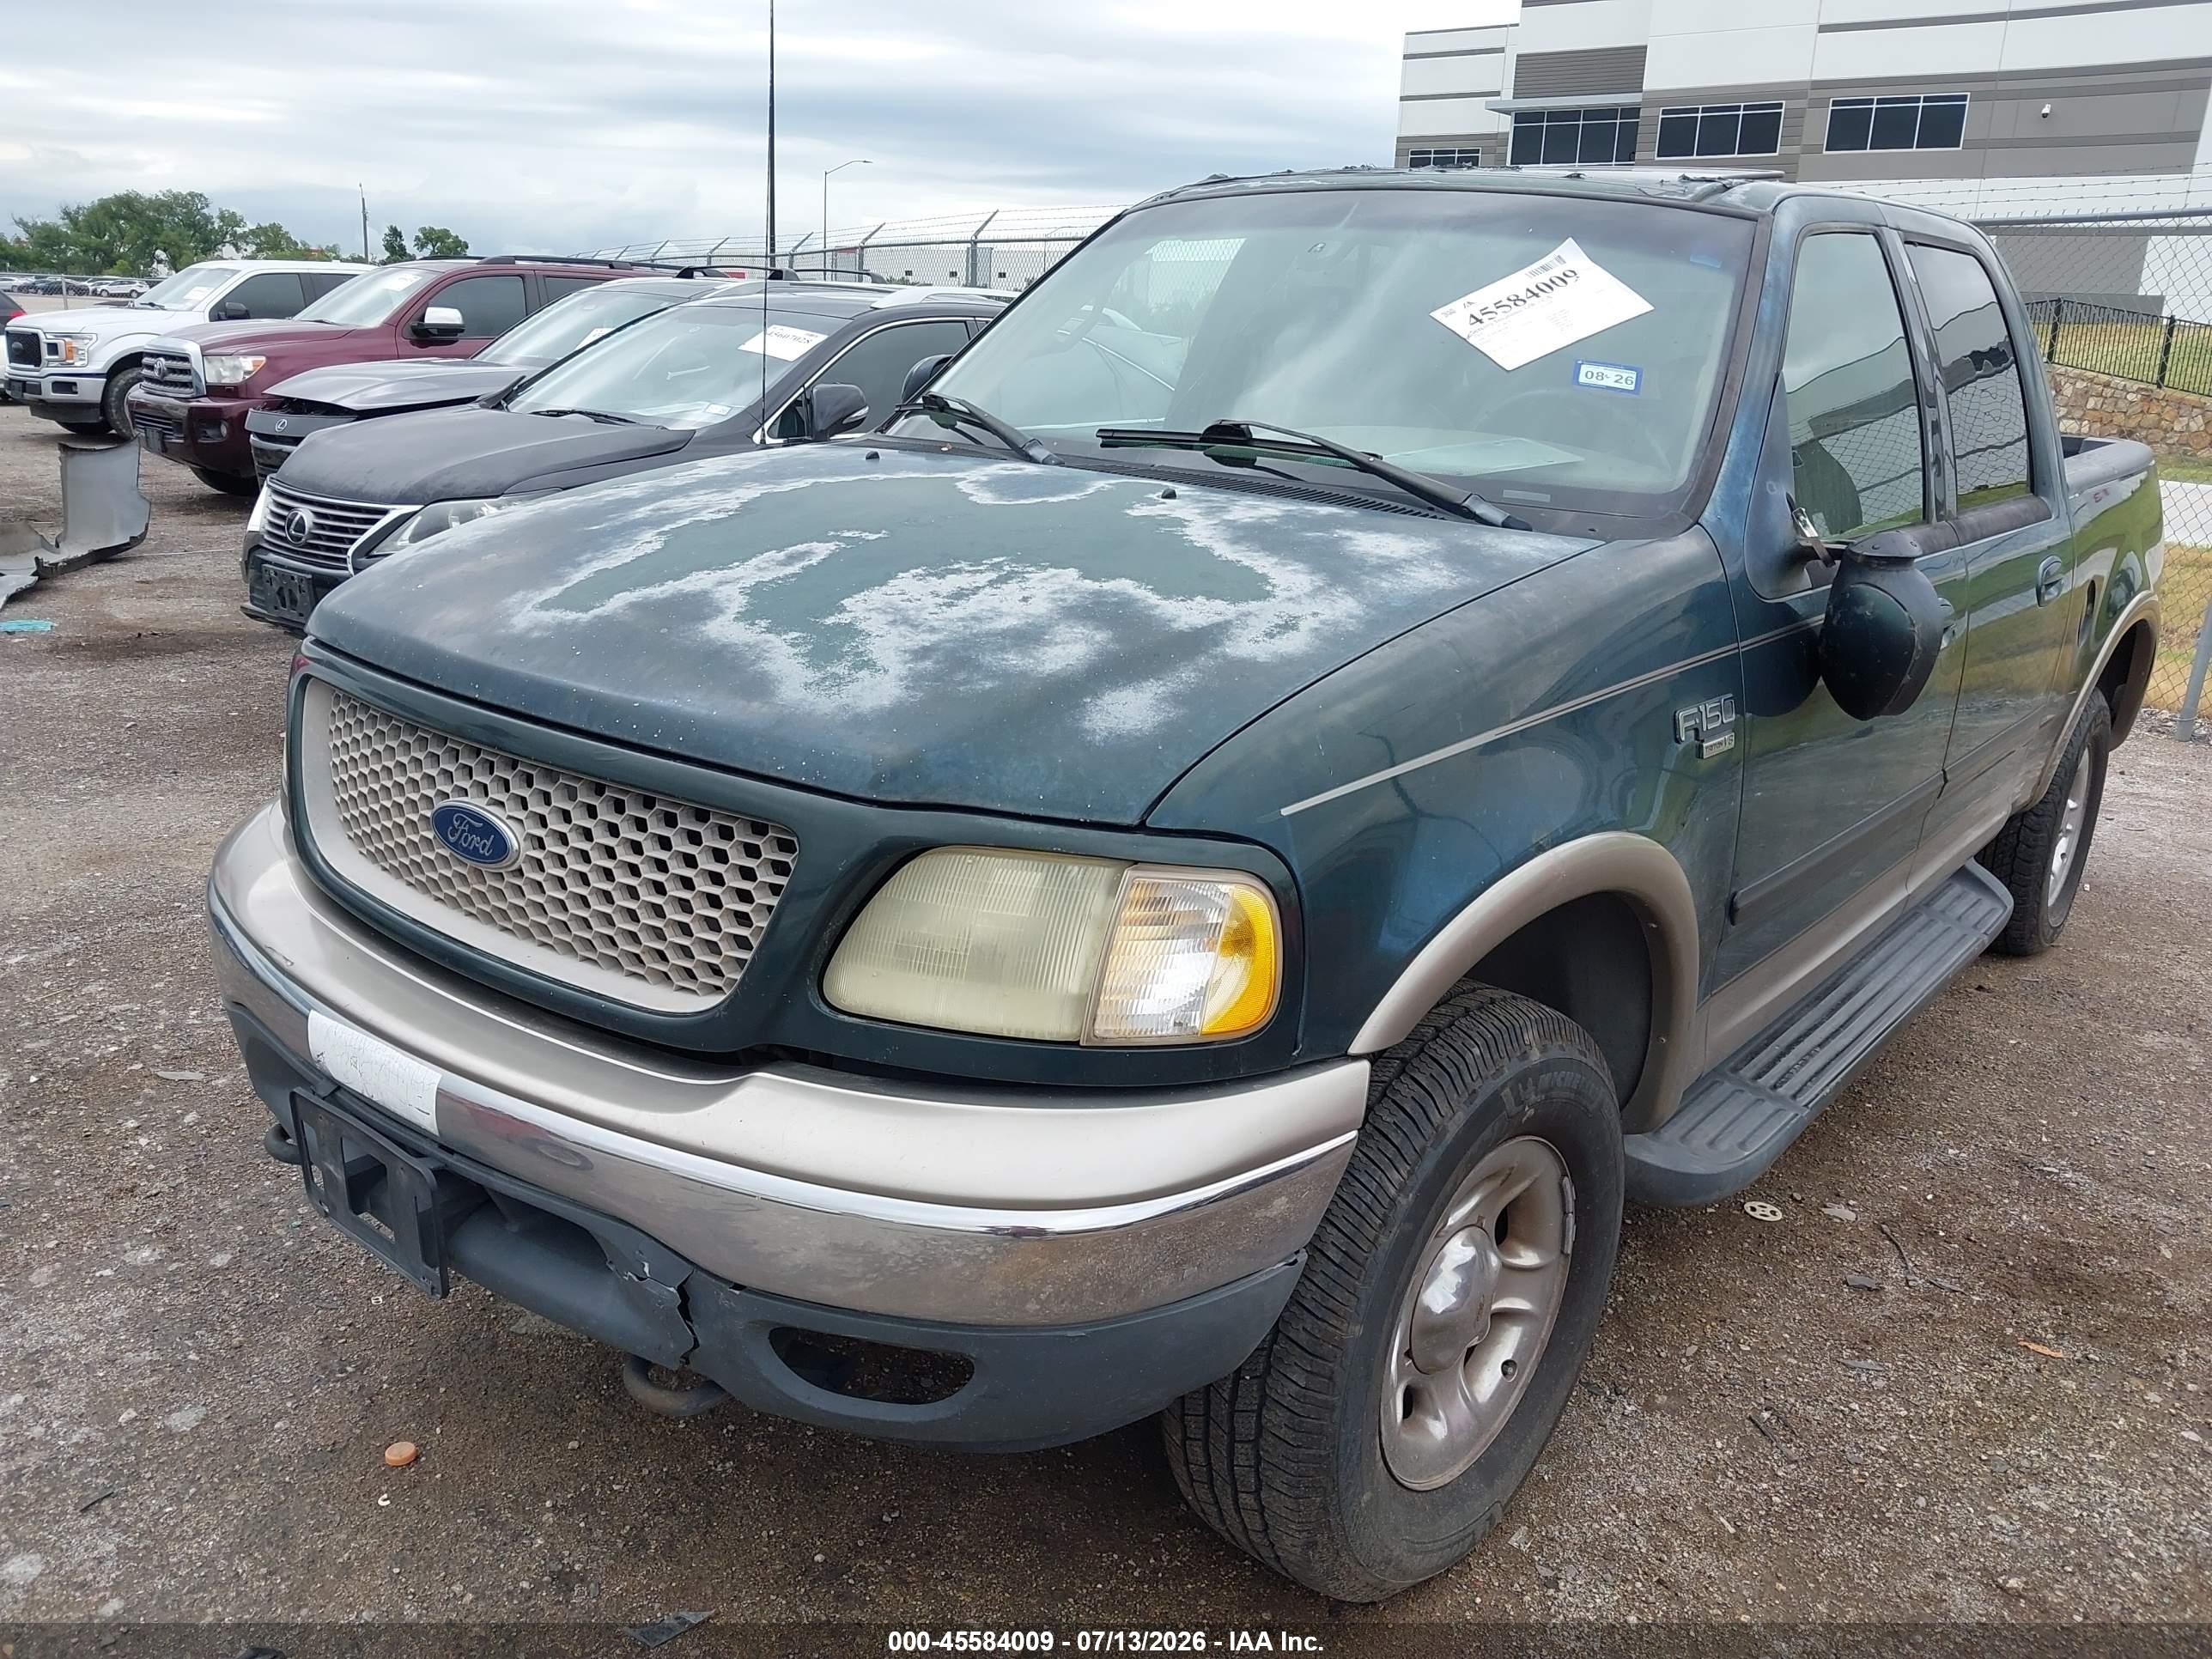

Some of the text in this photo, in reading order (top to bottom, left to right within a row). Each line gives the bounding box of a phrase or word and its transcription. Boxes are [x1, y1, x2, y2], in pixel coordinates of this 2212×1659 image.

[1468, 269, 1580, 325] 45584009
[1584, 370, 1604, 381] 08
[1613, 374, 1635, 386] 26
[447, 813, 494, 856] Ford
